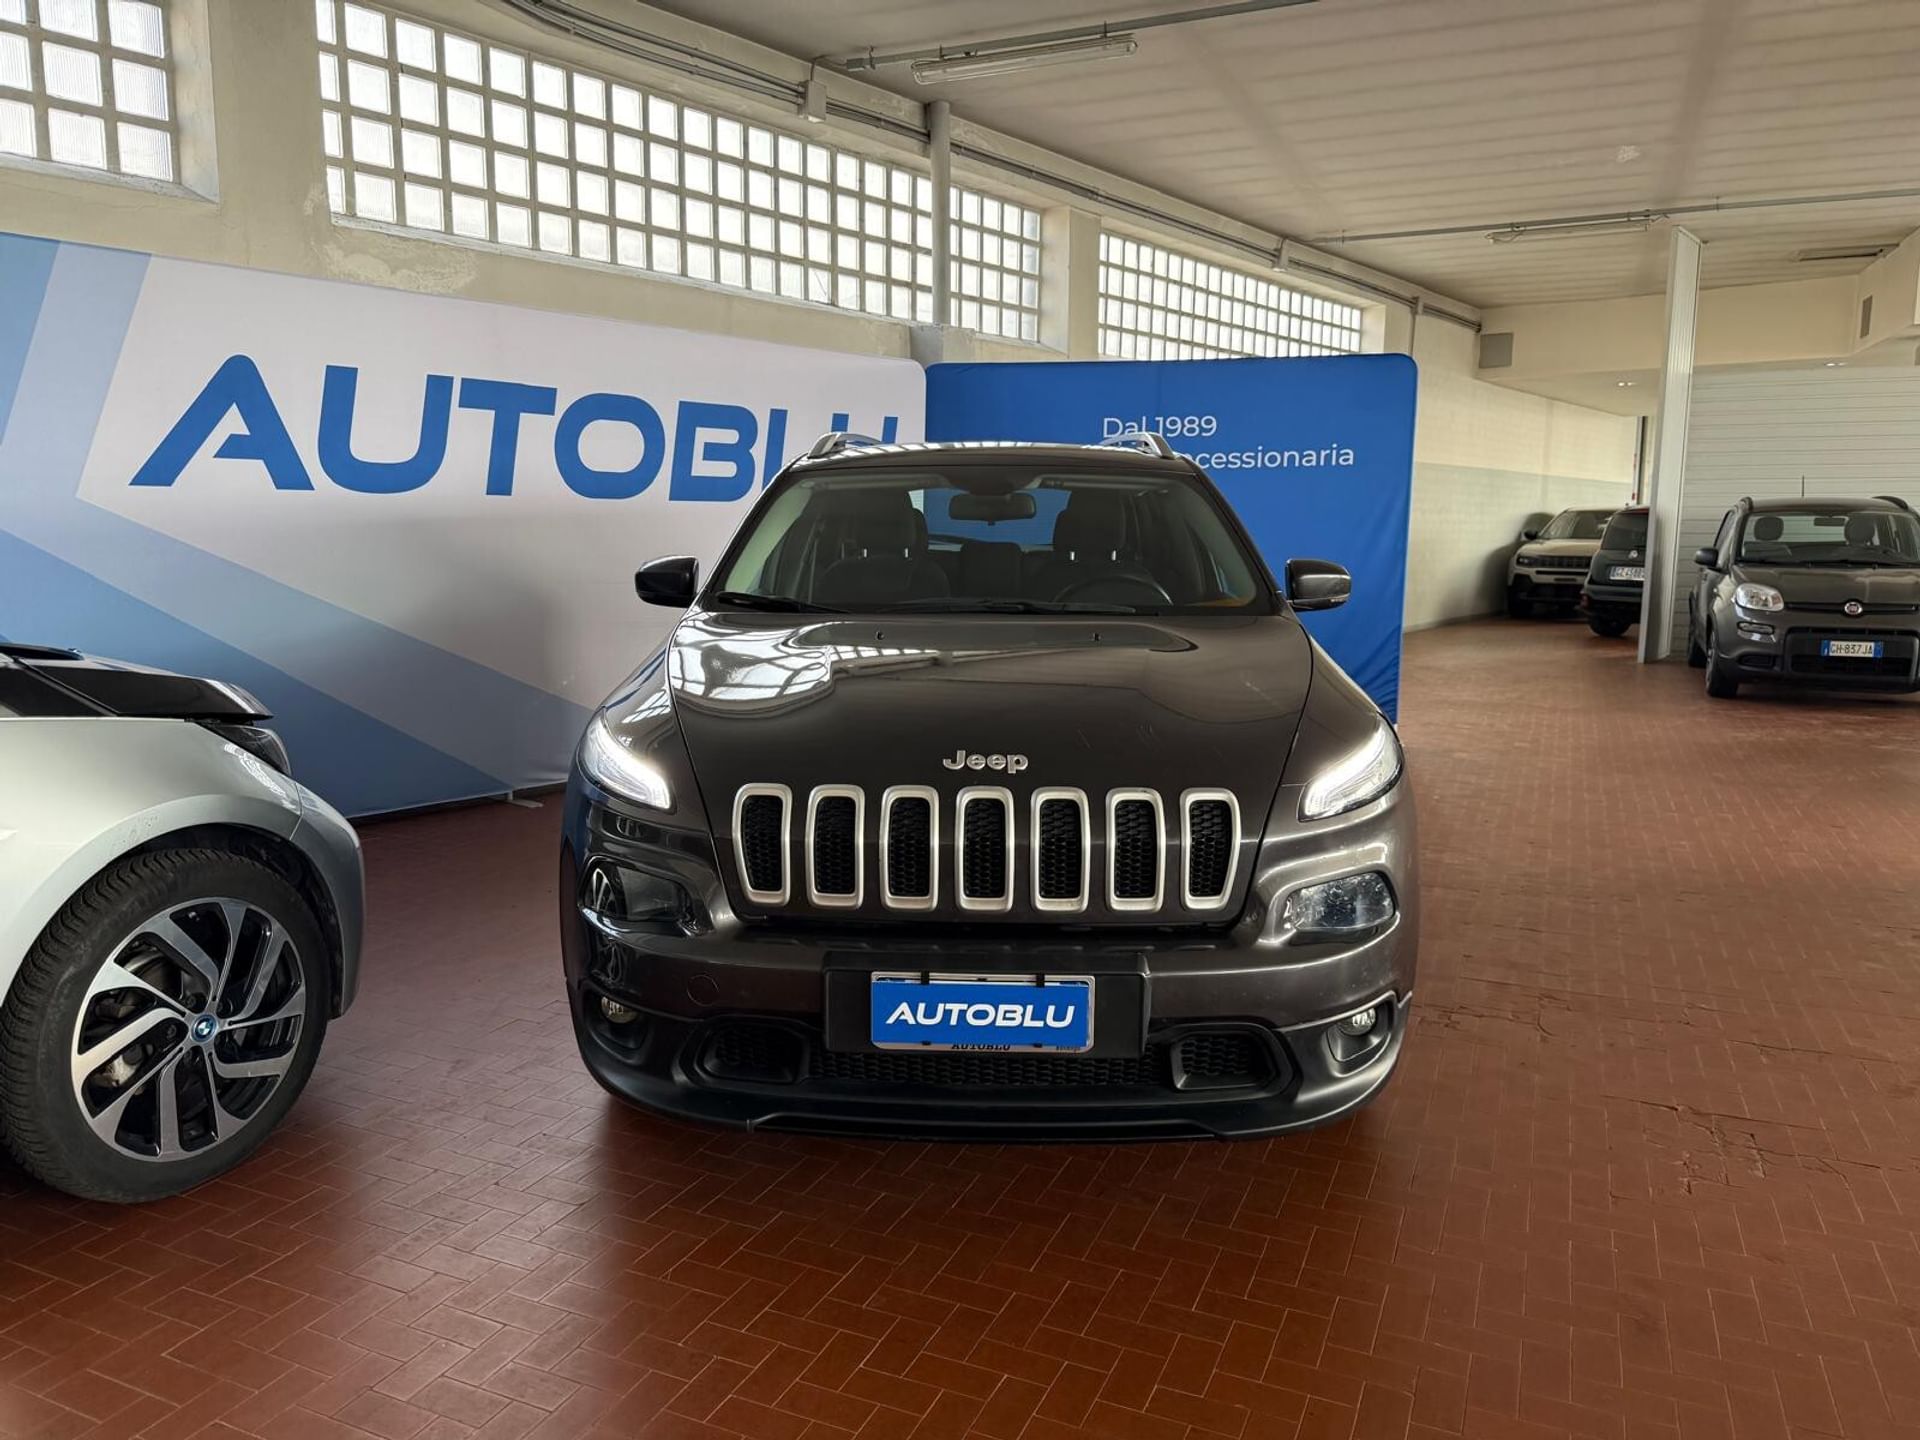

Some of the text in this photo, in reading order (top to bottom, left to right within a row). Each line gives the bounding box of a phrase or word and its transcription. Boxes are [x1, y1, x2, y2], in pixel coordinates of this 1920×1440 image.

[1103, 415, 1218, 438] Dal 1989
[1185, 444, 1354, 469] cessionaria
[943, 750, 1029, 774] Jeep
[886, 1002, 1075, 1028] AUTOBLU
